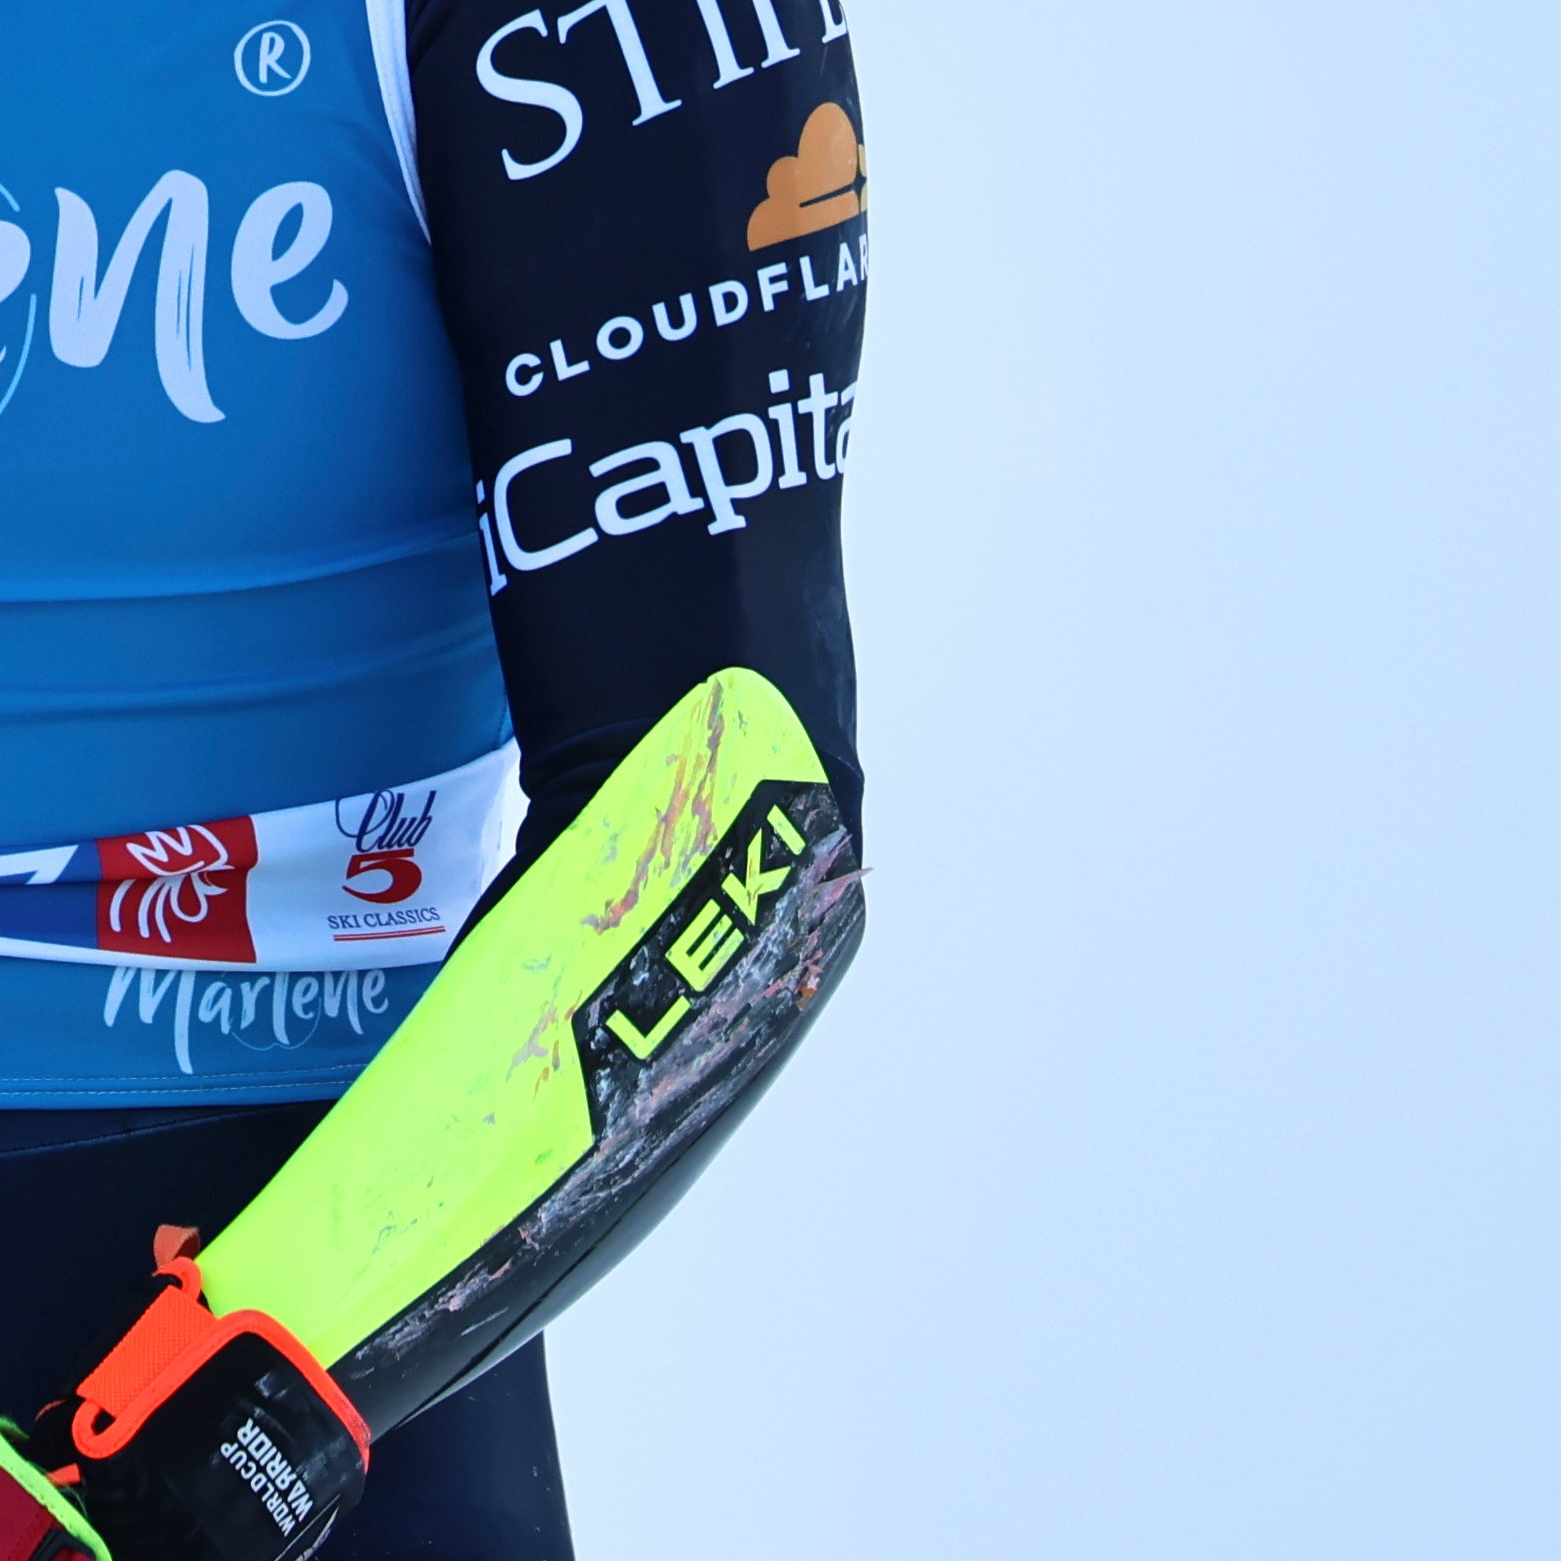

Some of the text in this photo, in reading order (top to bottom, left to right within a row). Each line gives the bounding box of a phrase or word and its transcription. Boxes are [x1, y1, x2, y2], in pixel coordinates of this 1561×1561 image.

[335, 789, 437, 853] Club
[342, 848, 423, 904] 5
[327, 906, 440, 930] SKI CLASSICS
[605, 804, 806, 1060] LEKI
